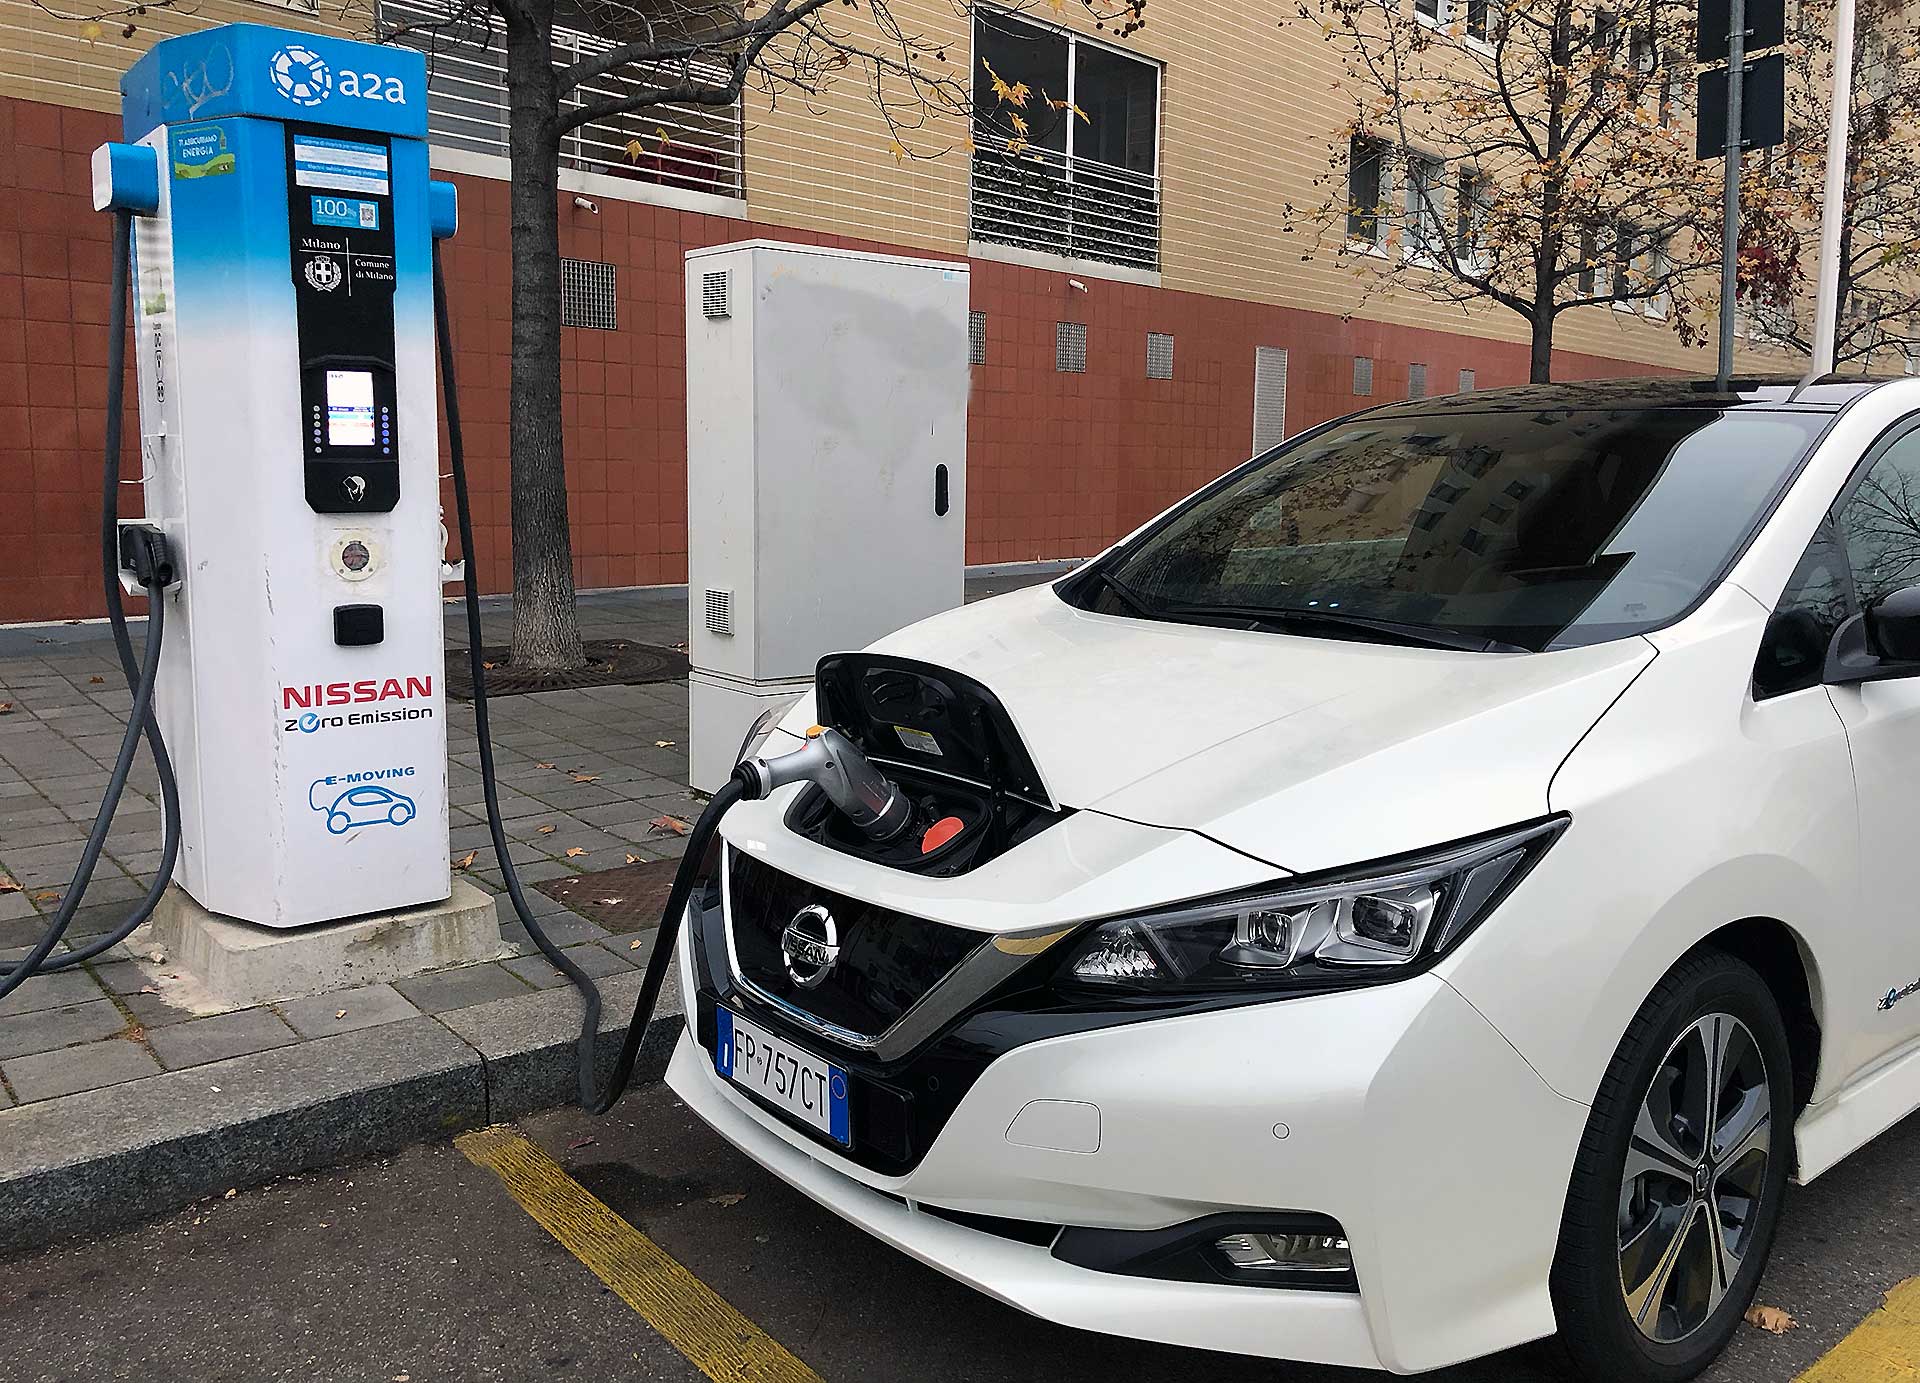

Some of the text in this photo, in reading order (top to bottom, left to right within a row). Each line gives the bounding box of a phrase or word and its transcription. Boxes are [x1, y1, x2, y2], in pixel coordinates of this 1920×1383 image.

[338, 69, 407, 105] a2a
[182, 146, 214, 159] ENERGIA
[302, 238, 341, 250] Milano
[355, 259, 390, 269] Comune
[355, 271, 394, 281] di Milano
[283, 675, 432, 710] NISSAN
[348, 707, 433, 726] Emission
[327, 766, 416, 786] E-MOVING
